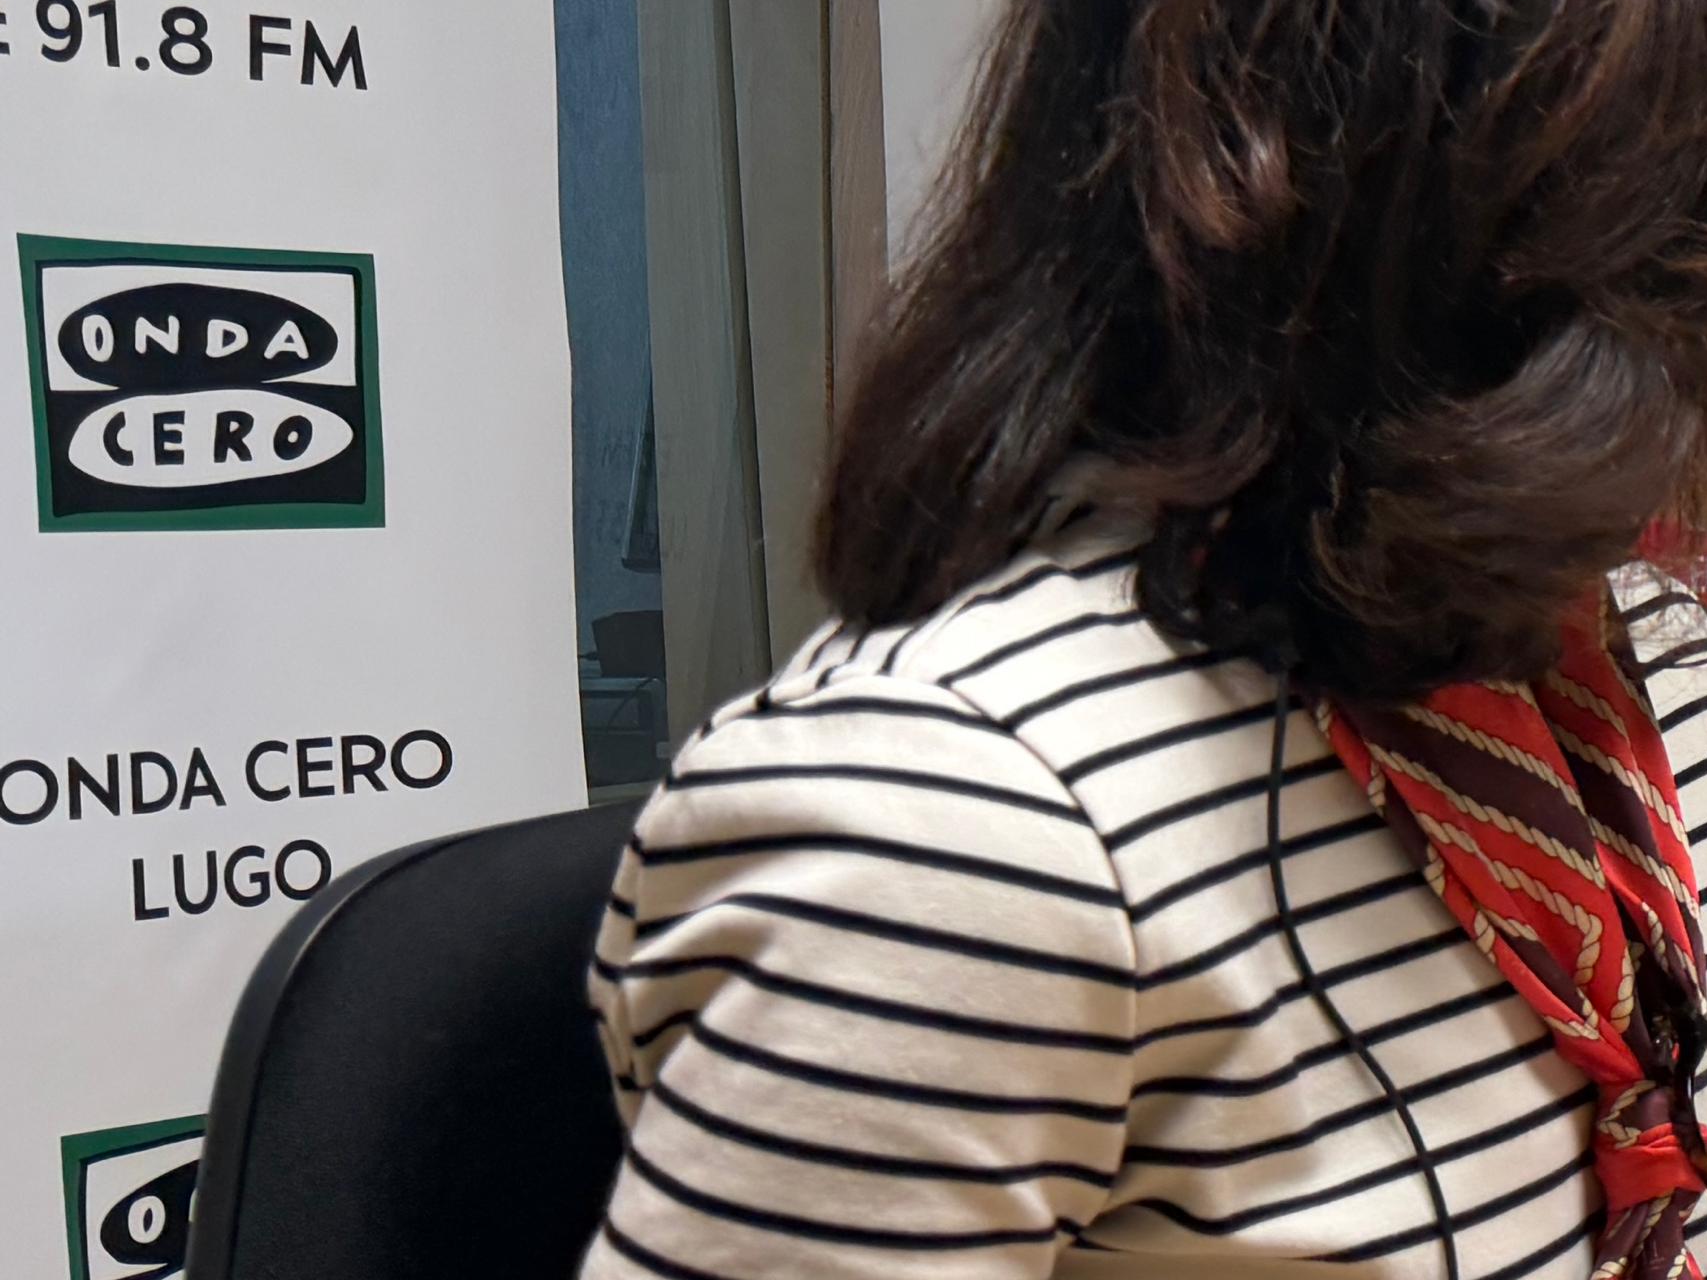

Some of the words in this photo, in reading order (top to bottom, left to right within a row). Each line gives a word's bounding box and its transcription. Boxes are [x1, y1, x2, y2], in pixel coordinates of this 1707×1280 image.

[250, 15, 367, 90] FM
[82, 315, 308, 362] ONDA
[103, 411, 312, 466] CERO
[0, 748, 226, 825] ONDA
[246, 730, 452, 801] CERO
[132, 839, 331, 921] LUGO
